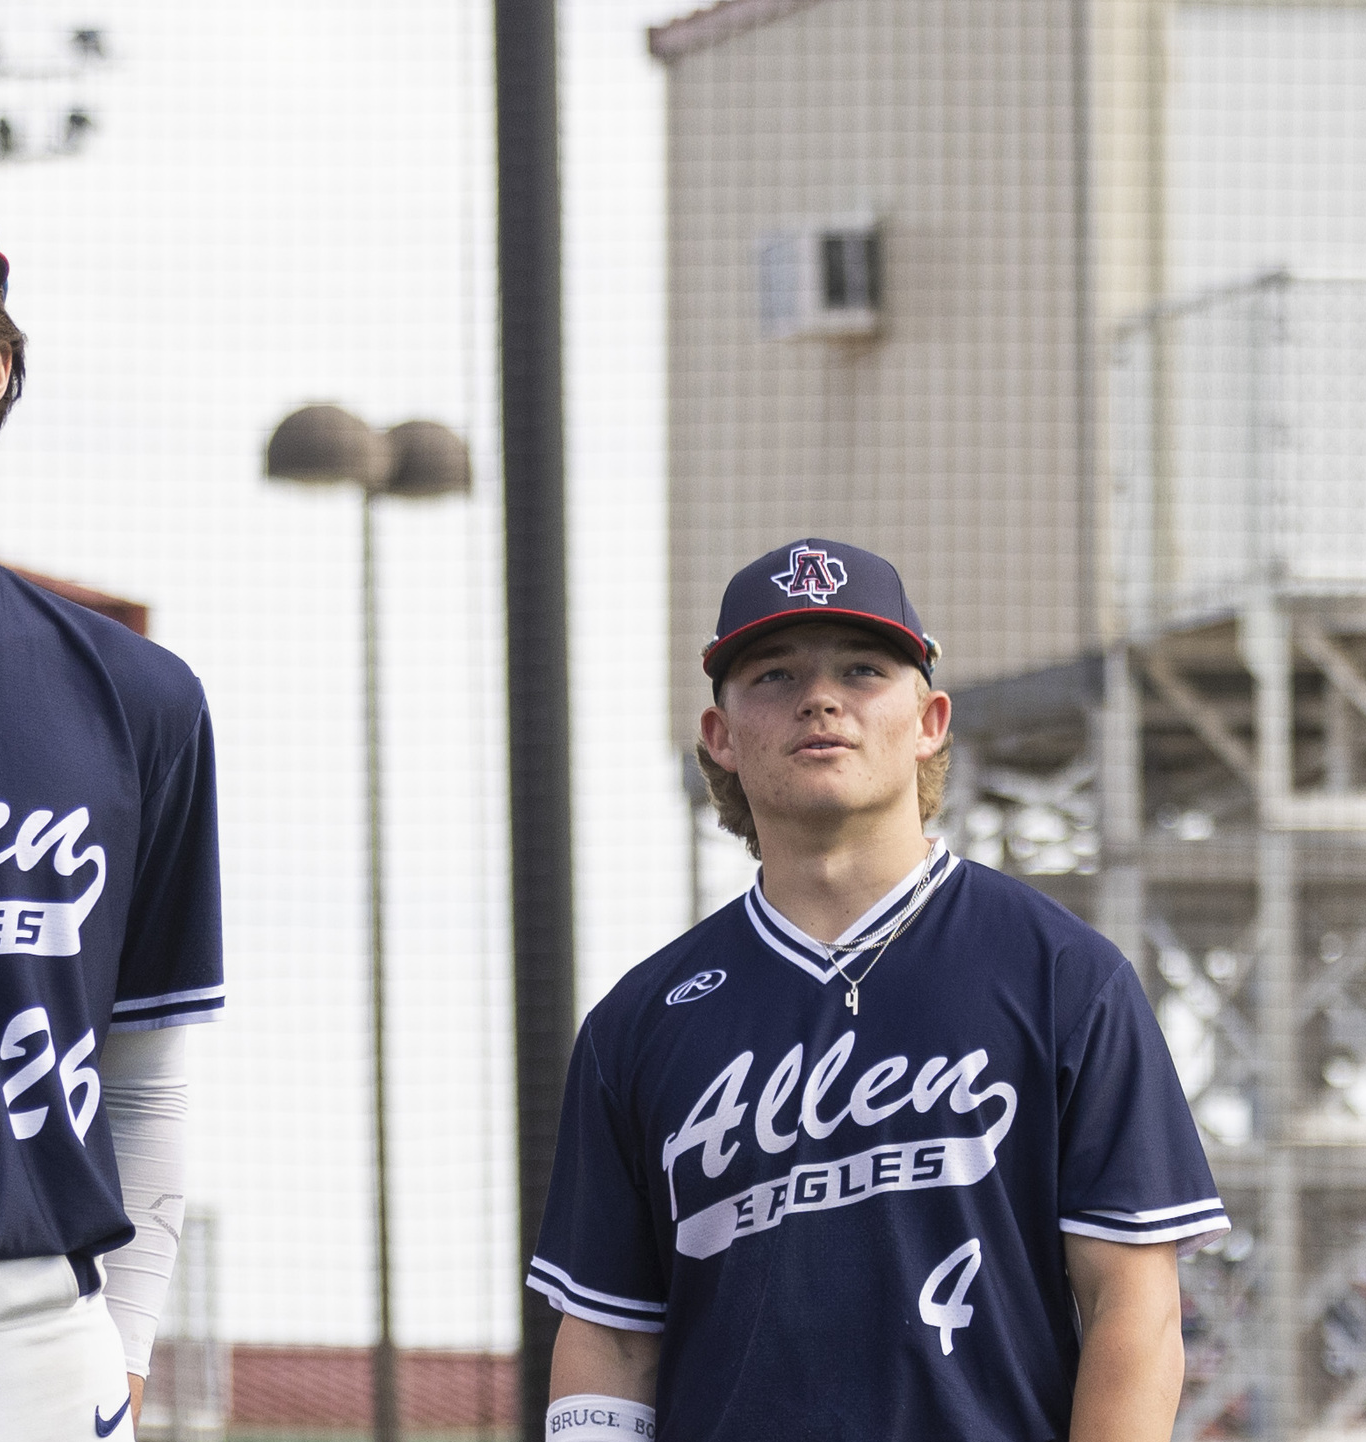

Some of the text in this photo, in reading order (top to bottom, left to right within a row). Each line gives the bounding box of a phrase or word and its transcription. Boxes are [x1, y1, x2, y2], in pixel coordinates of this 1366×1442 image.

[788, 550, 837, 597] A
[0, 1006, 101, 1147] 26
[662, 1030, 1017, 1190] Allen
[733, 1146, 946, 1231] EAGLES
[919, 1238, 981, 1356] 4
[549, 1409, 620, 1435] BRUCE
